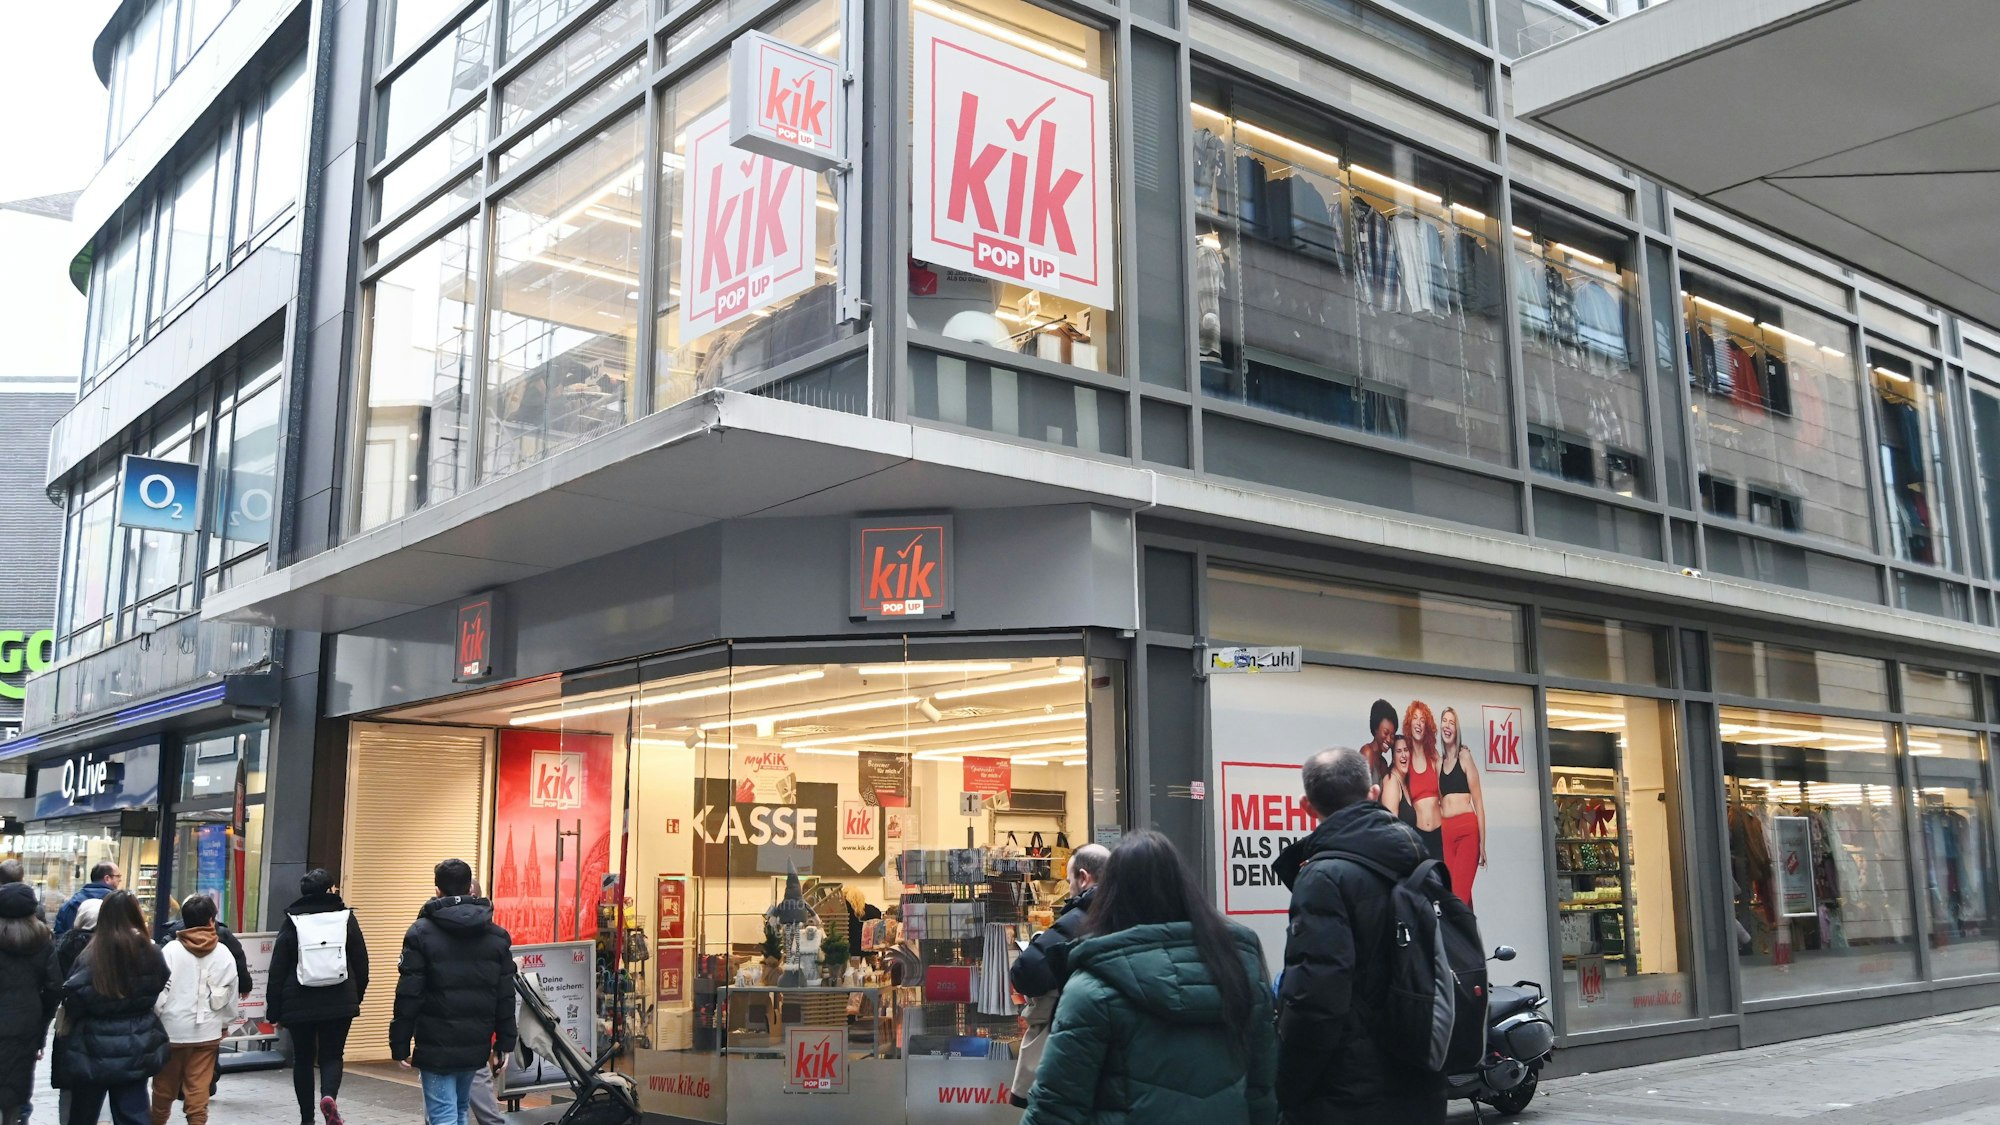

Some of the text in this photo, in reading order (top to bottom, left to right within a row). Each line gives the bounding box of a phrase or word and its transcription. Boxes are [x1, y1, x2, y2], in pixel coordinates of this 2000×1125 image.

[765, 66, 827, 136] kik
[778, 127, 812, 143] POP UP
[947, 91, 1084, 256] kik
[700, 153, 795, 294] kik
[977, 242, 1055, 279] POP UP
[717, 275, 771, 315] POP UP
[868, 533, 936, 600] kik
[882, 602, 921, 612] POP UP
[459, 609, 487, 664] kik
[1489, 712, 1520, 765] kik
[77, 752, 107, 797] Live
[537, 757, 576, 800] kik
[693, 805, 818, 847] KASSE
[846, 807, 871, 835] kik
[1231, 836, 1272, 859] ALS
[1233, 864, 1282, 886] DEN
[523, 950, 585, 965] KiK kik
[542, 976, 564, 984] Deine
[556, 983, 585, 992] sichern:
[1582, 962, 1602, 995] kik
[1633, 989, 1682, 1009] www.kik.de
[795, 1034, 840, 1079] kik
[649, 1074, 710, 1099] www.kik.de
